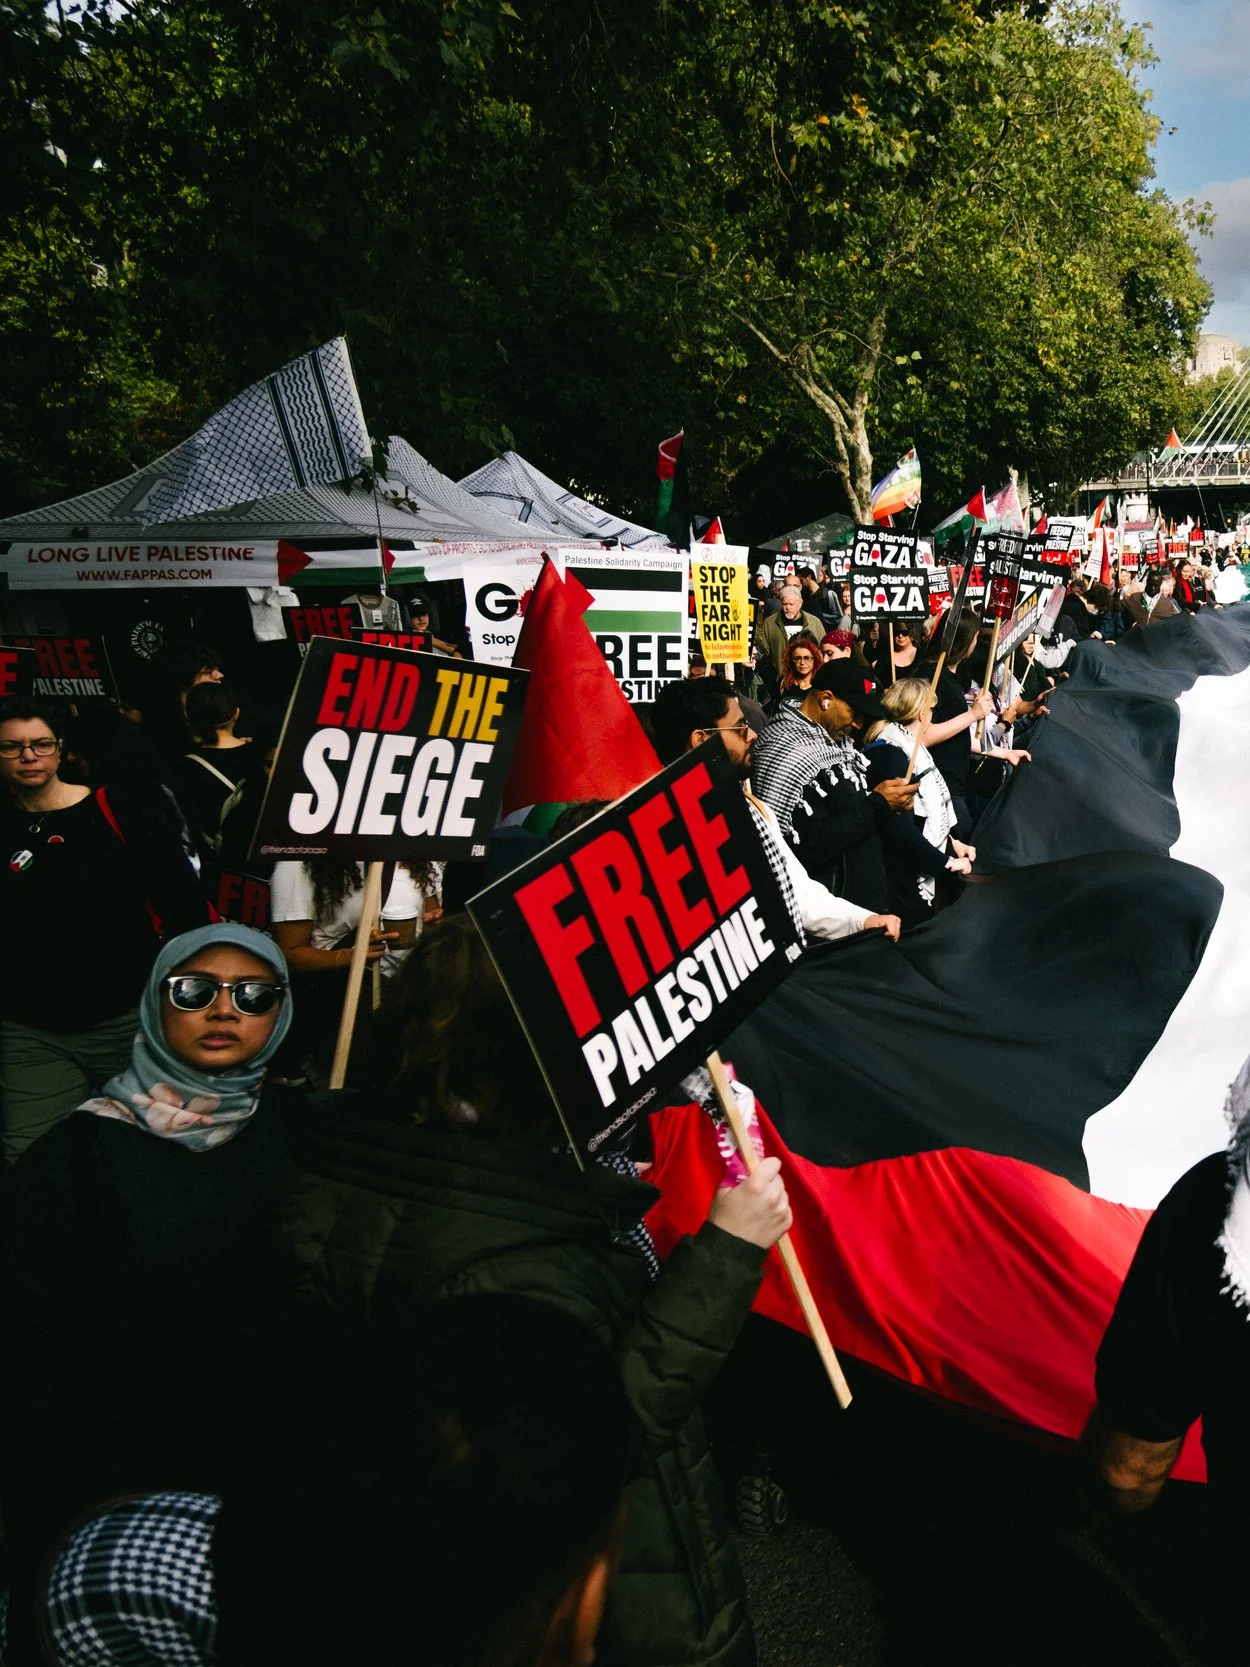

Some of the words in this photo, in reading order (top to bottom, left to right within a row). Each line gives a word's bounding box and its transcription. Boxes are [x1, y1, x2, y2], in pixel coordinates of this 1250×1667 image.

[857, 530, 876, 541] Stop
[878, 532, 915, 546] Starving
[1190, 532, 1203, 541] FREE
[28, 548, 90, 563] LONG
[97, 547, 140, 562] LIVE
[147, 546, 255, 561] PALESTINE
[855, 542, 911, 568] GAZA
[1169, 543, 1187, 553] FREE
[565, 555, 603, 565] Palestine
[605, 557, 641, 567] Solidarity
[643, 559, 683, 569] Campaign
[792, 555, 819, 565] Starving
[831, 558, 851, 576] GA
[1122, 553, 1138, 566] FREE
[77, 569, 212, 581] WWW.FAPPAS.COM
[699, 566, 736, 584] STOP
[853, 574, 878, 586] Stop
[880, 574, 924, 586] Starving
[1020, 567, 1063, 584] tarving
[700, 585, 730, 602] THE
[854, 587, 925, 612] GAZA
[701, 605, 730, 622] FAR
[1017, 592, 1038, 620] GAZA
[290, 607, 353, 642] FREE
[703, 624, 742, 641] RIGHT
[482, 633, 515, 645] Stop
[15, 639, 99, 679] REE
[596, 635, 682, 678] REE
[316, 652, 420, 732] END
[428, 669, 509, 742] THE
[289, 728, 494, 837] SIEGE
[218, 872, 270, 928] FR
[513, 762, 752, 1039] FREE
[582, 896, 775, 1108] PALESTINE
